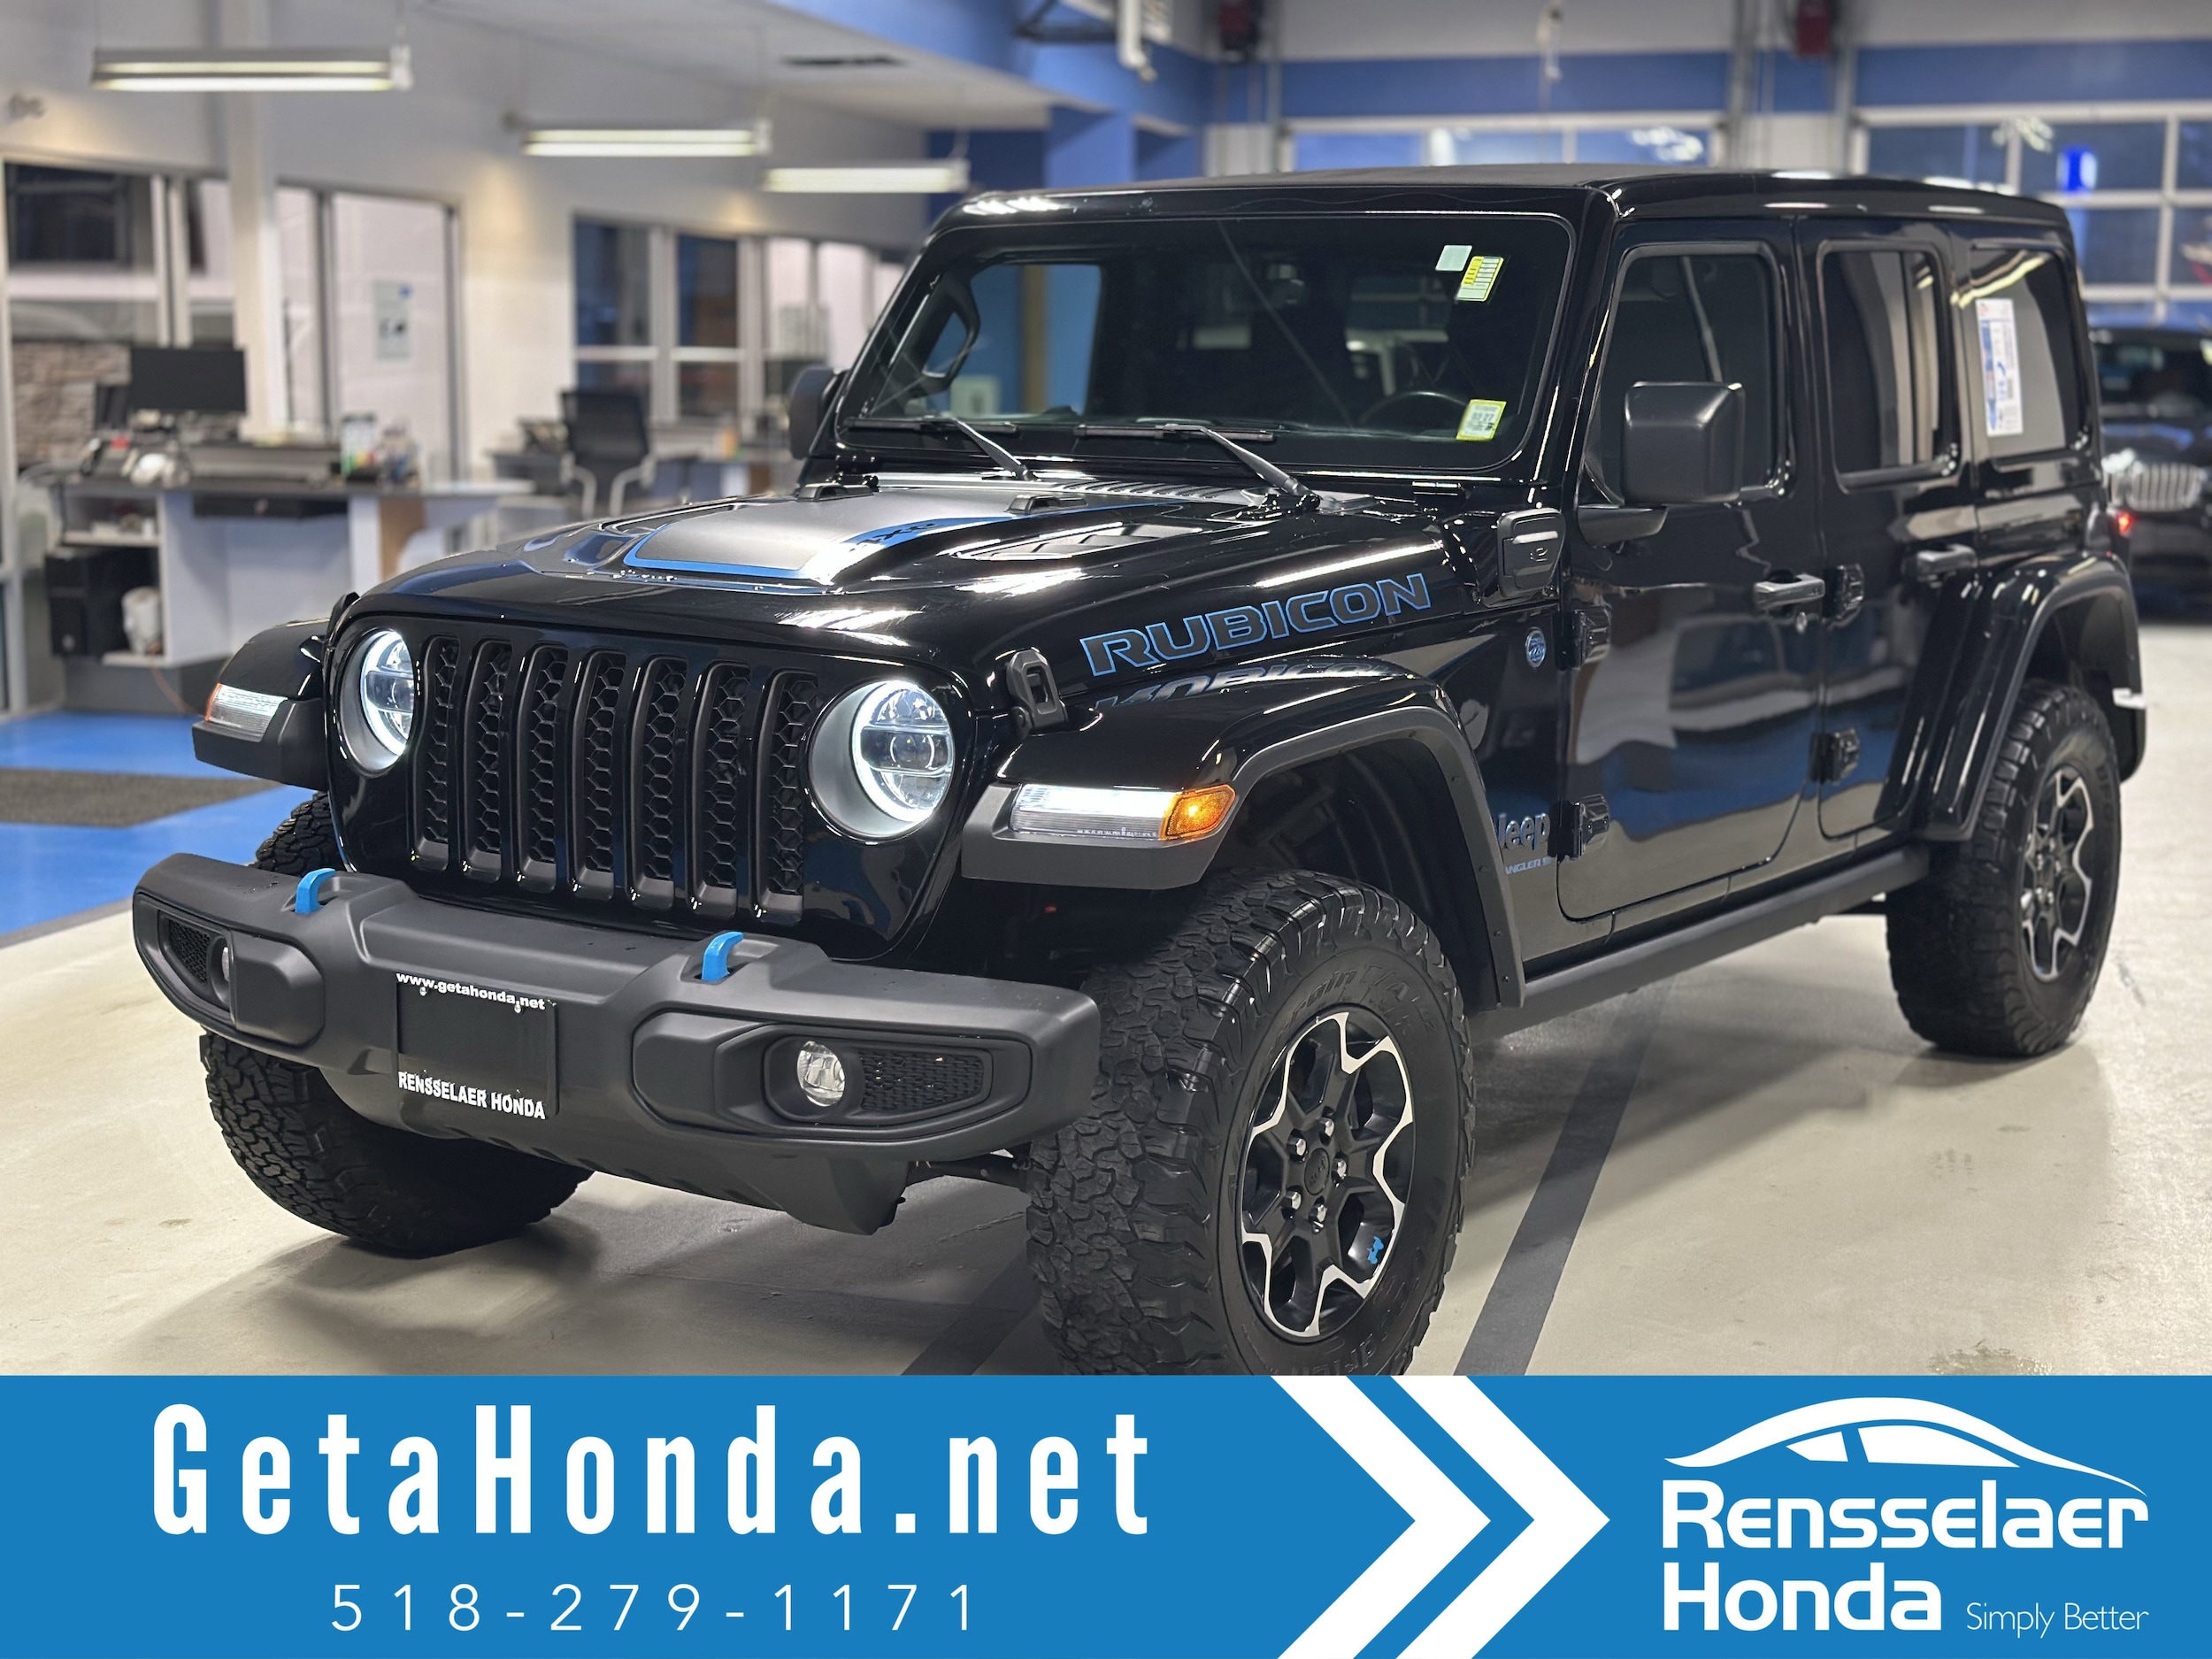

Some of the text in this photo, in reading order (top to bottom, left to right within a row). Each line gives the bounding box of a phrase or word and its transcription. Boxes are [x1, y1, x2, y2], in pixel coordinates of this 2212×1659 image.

[1079, 573, 1432, 677] RUBICON
[1498, 812, 1551, 850] Jeep
[396, 972, 546, 1010] www.getahonda.net
[397, 1071, 546, 1119] RENSSELAER HONDA
